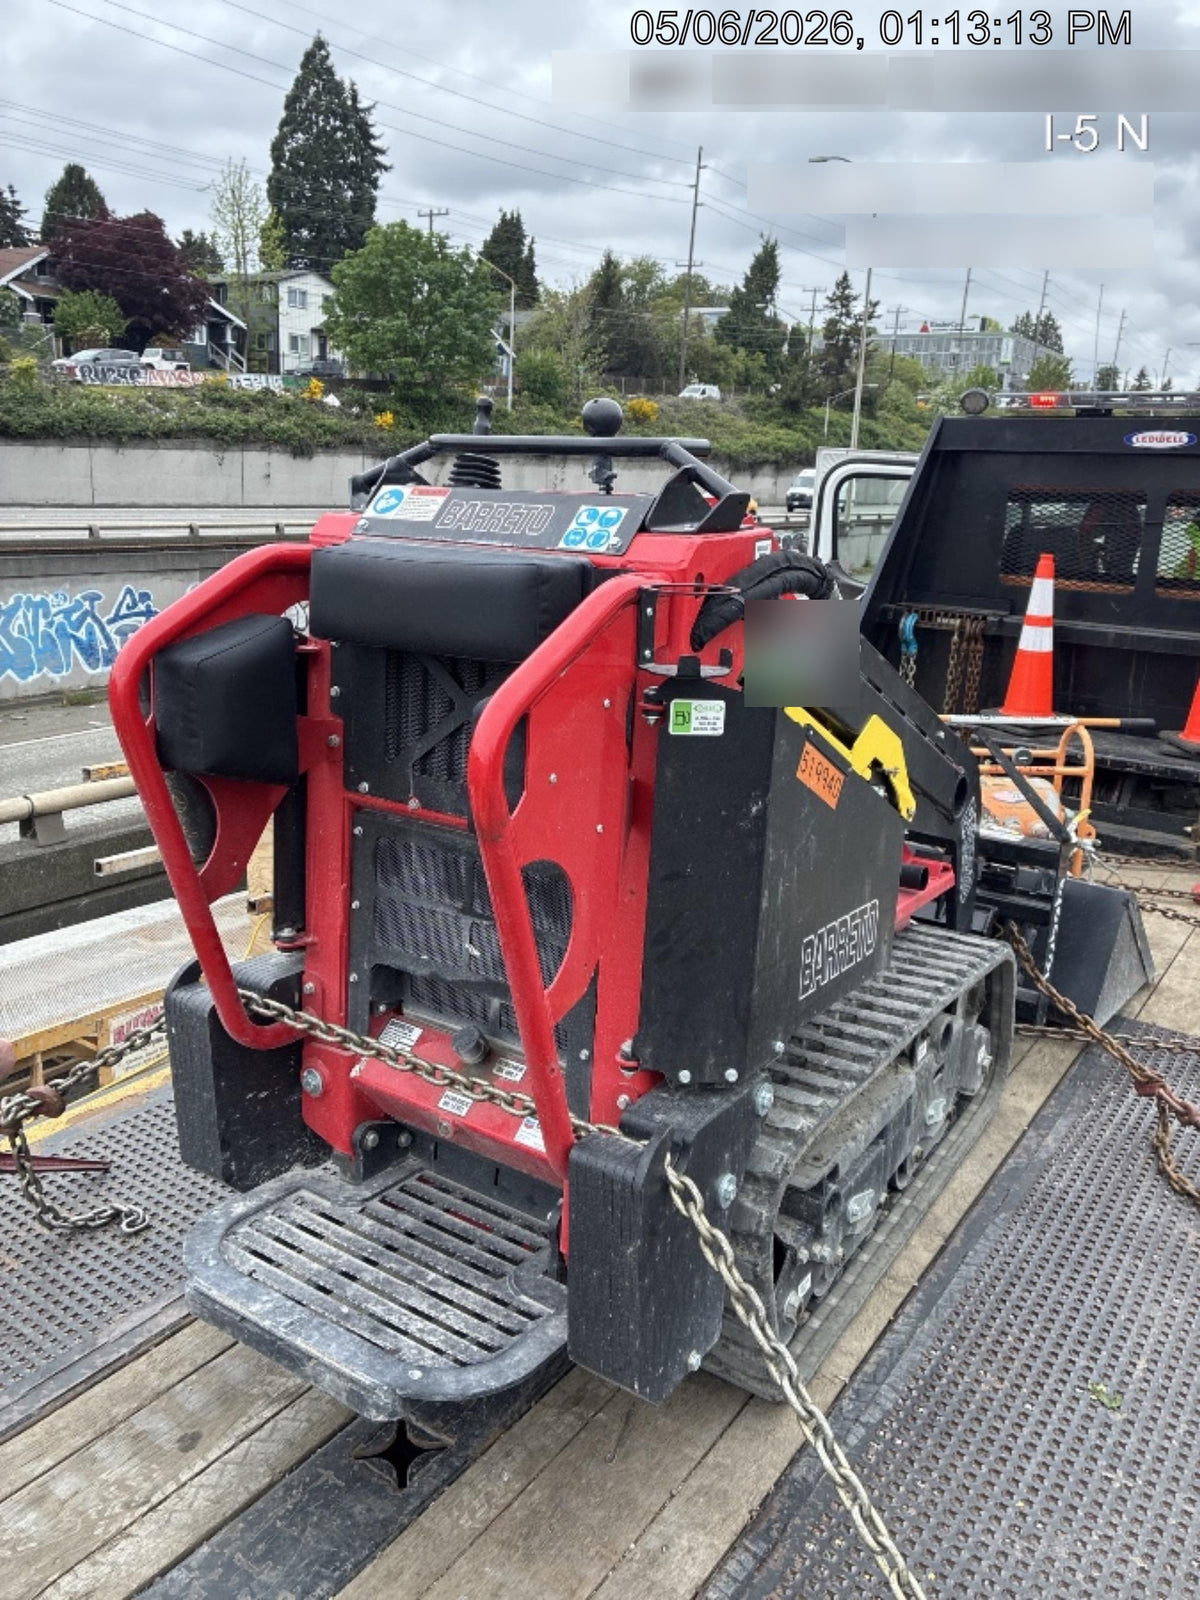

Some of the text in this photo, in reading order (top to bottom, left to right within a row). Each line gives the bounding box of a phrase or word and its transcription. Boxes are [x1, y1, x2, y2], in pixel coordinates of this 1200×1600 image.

[1135, 434, 1184, 444] LEDWELL
[435, 500, 555, 536] BARRETO
[799, 899, 879, 1000] BARRETO
